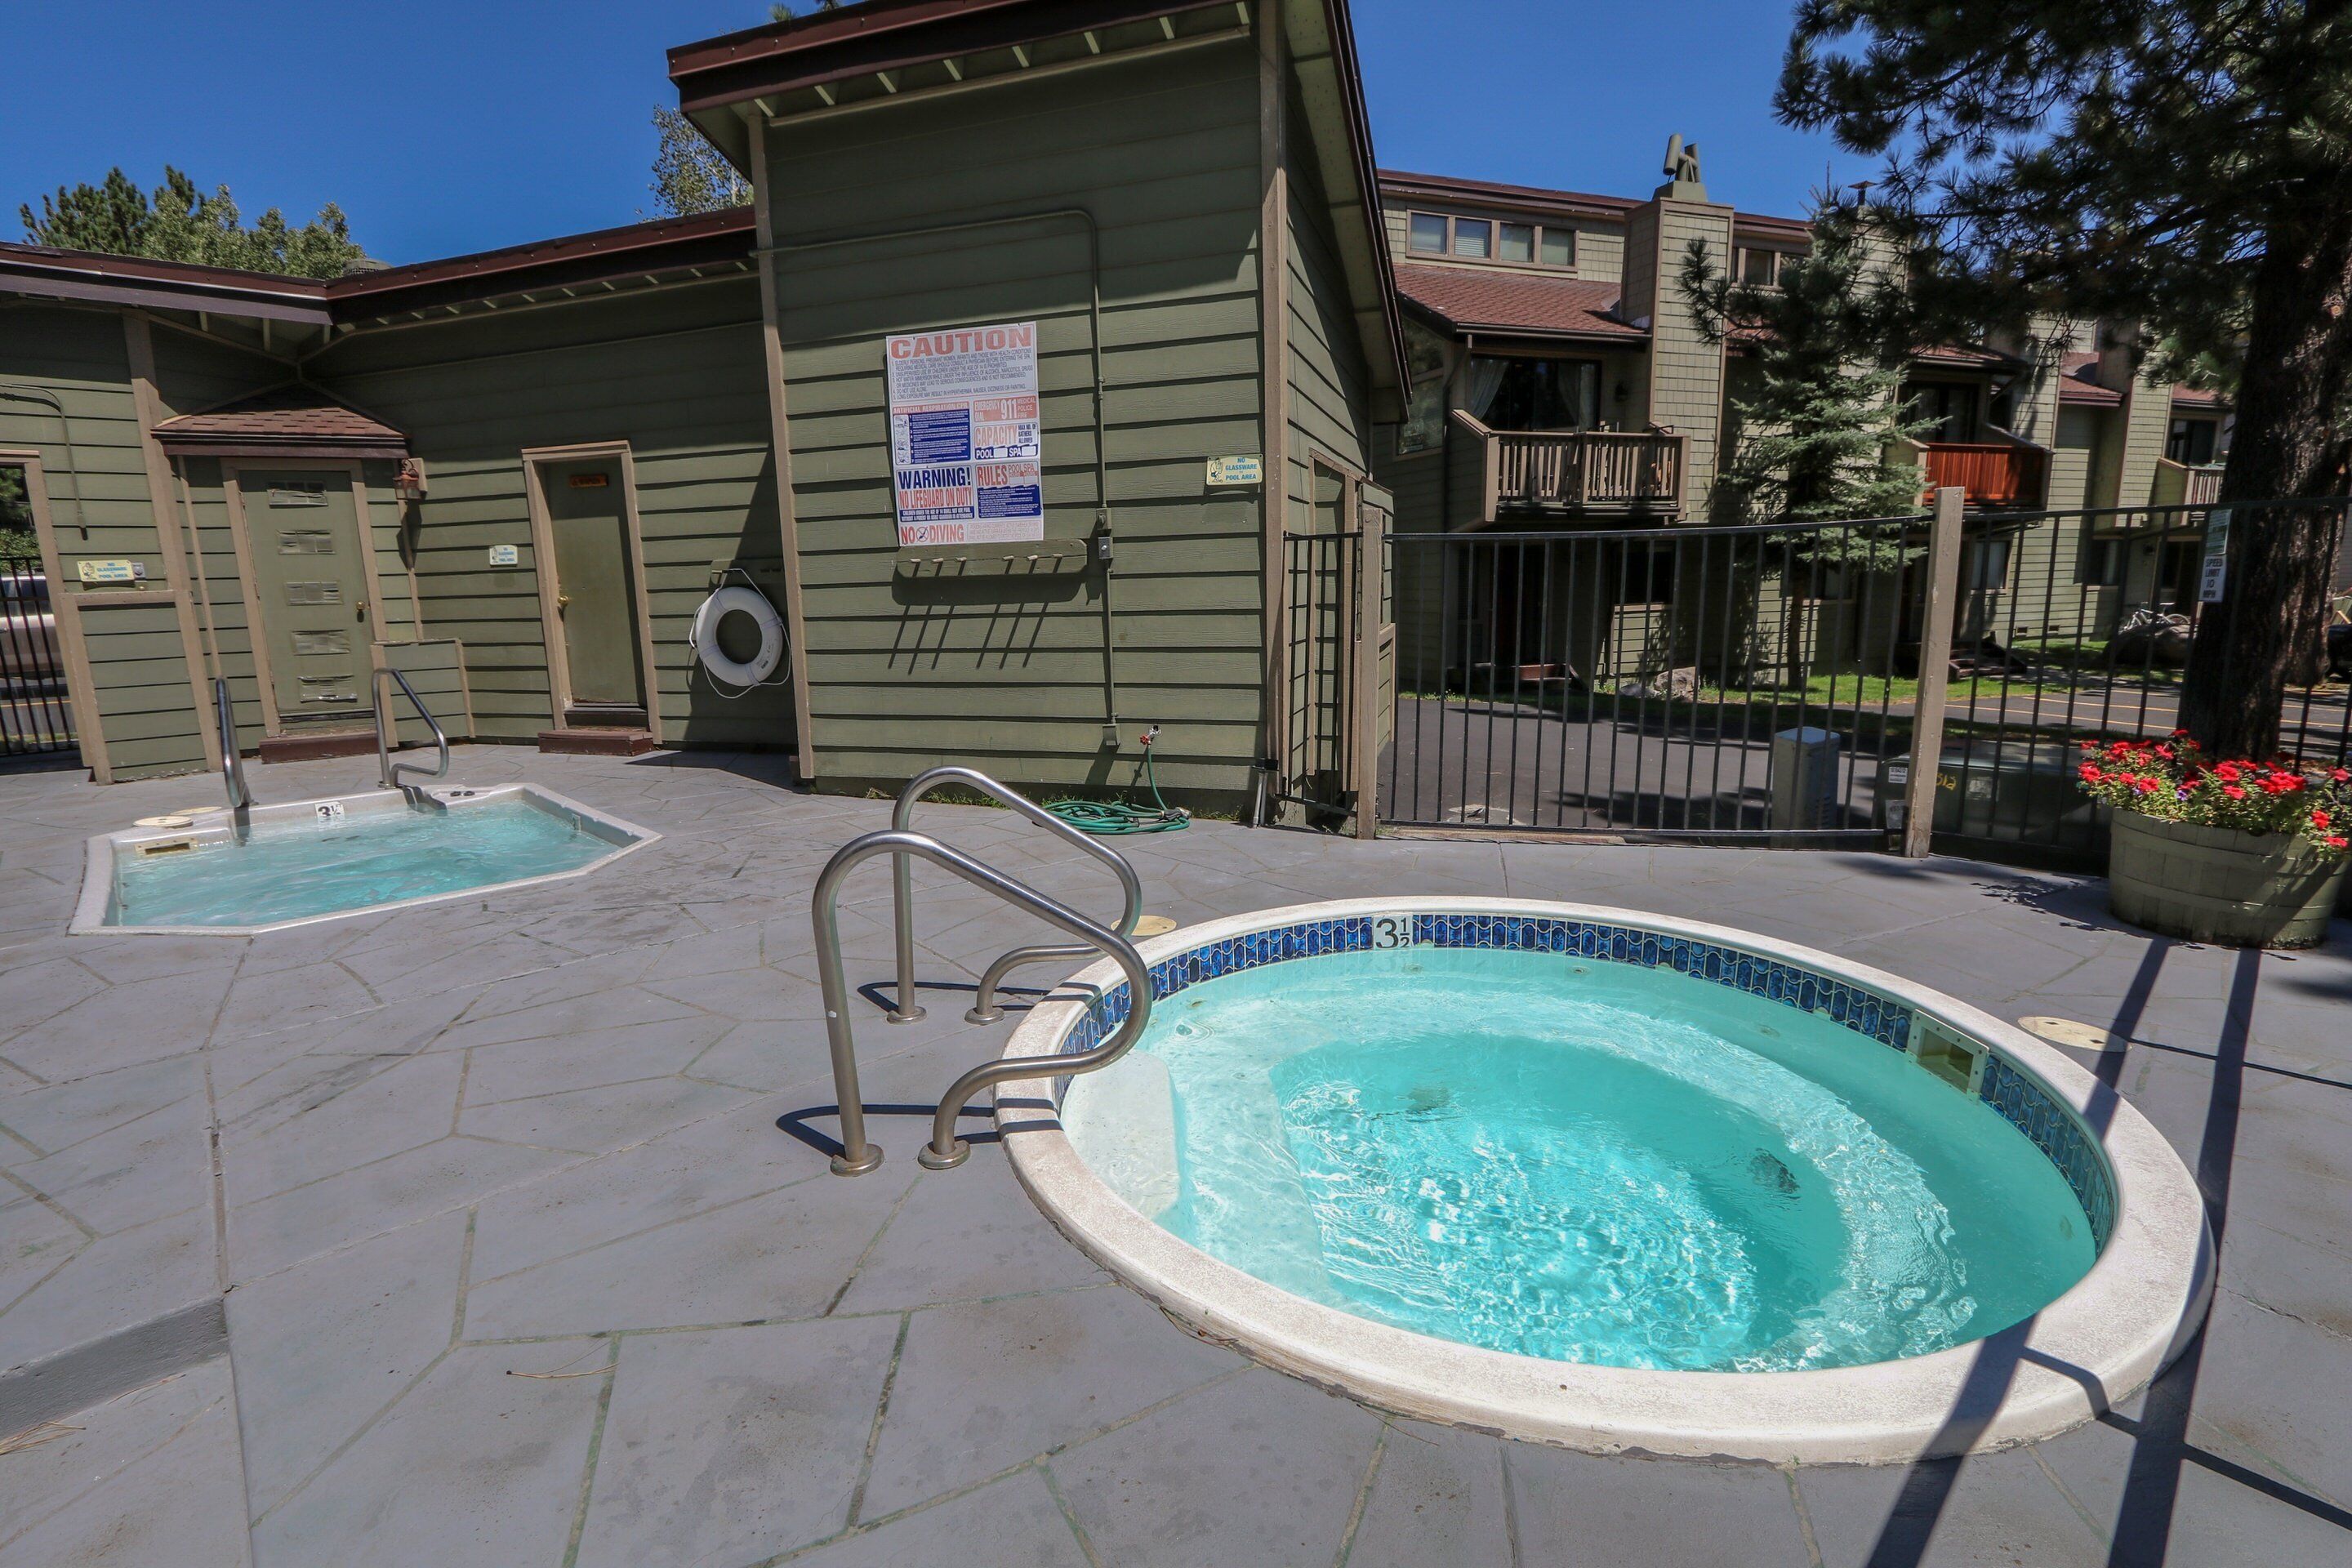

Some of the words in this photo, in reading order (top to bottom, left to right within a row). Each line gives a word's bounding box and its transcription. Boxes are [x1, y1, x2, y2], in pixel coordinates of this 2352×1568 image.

[891, 327, 1031, 359] CAUTION
[893, 406, 920, 414] ARTIFICIAL
[974, 400, 1000, 412] EMERGENCY
[975, 412, 984, 421] DIAL
[1000, 399, 1017, 420] 911
[975, 425, 1018, 447] CAPACITY
[977, 449, 993, 458] POOL
[1009, 448, 1021, 457] SPA
[898, 467, 970, 490] WARNING!
[977, 465, 1008, 487] RULES
[1009, 464, 1022, 473] POOL
[1023, 463, 1034, 471] SPA
[899, 491, 909, 509] NO
[910, 488, 944, 508] LIFEGUARD
[946, 488, 955, 506] ON
[956, 487, 972, 506] DUTY
[901, 526, 915, 544] NO
[929, 523, 964, 543] DIVING
[2207, 579, 2215, 588] 10
